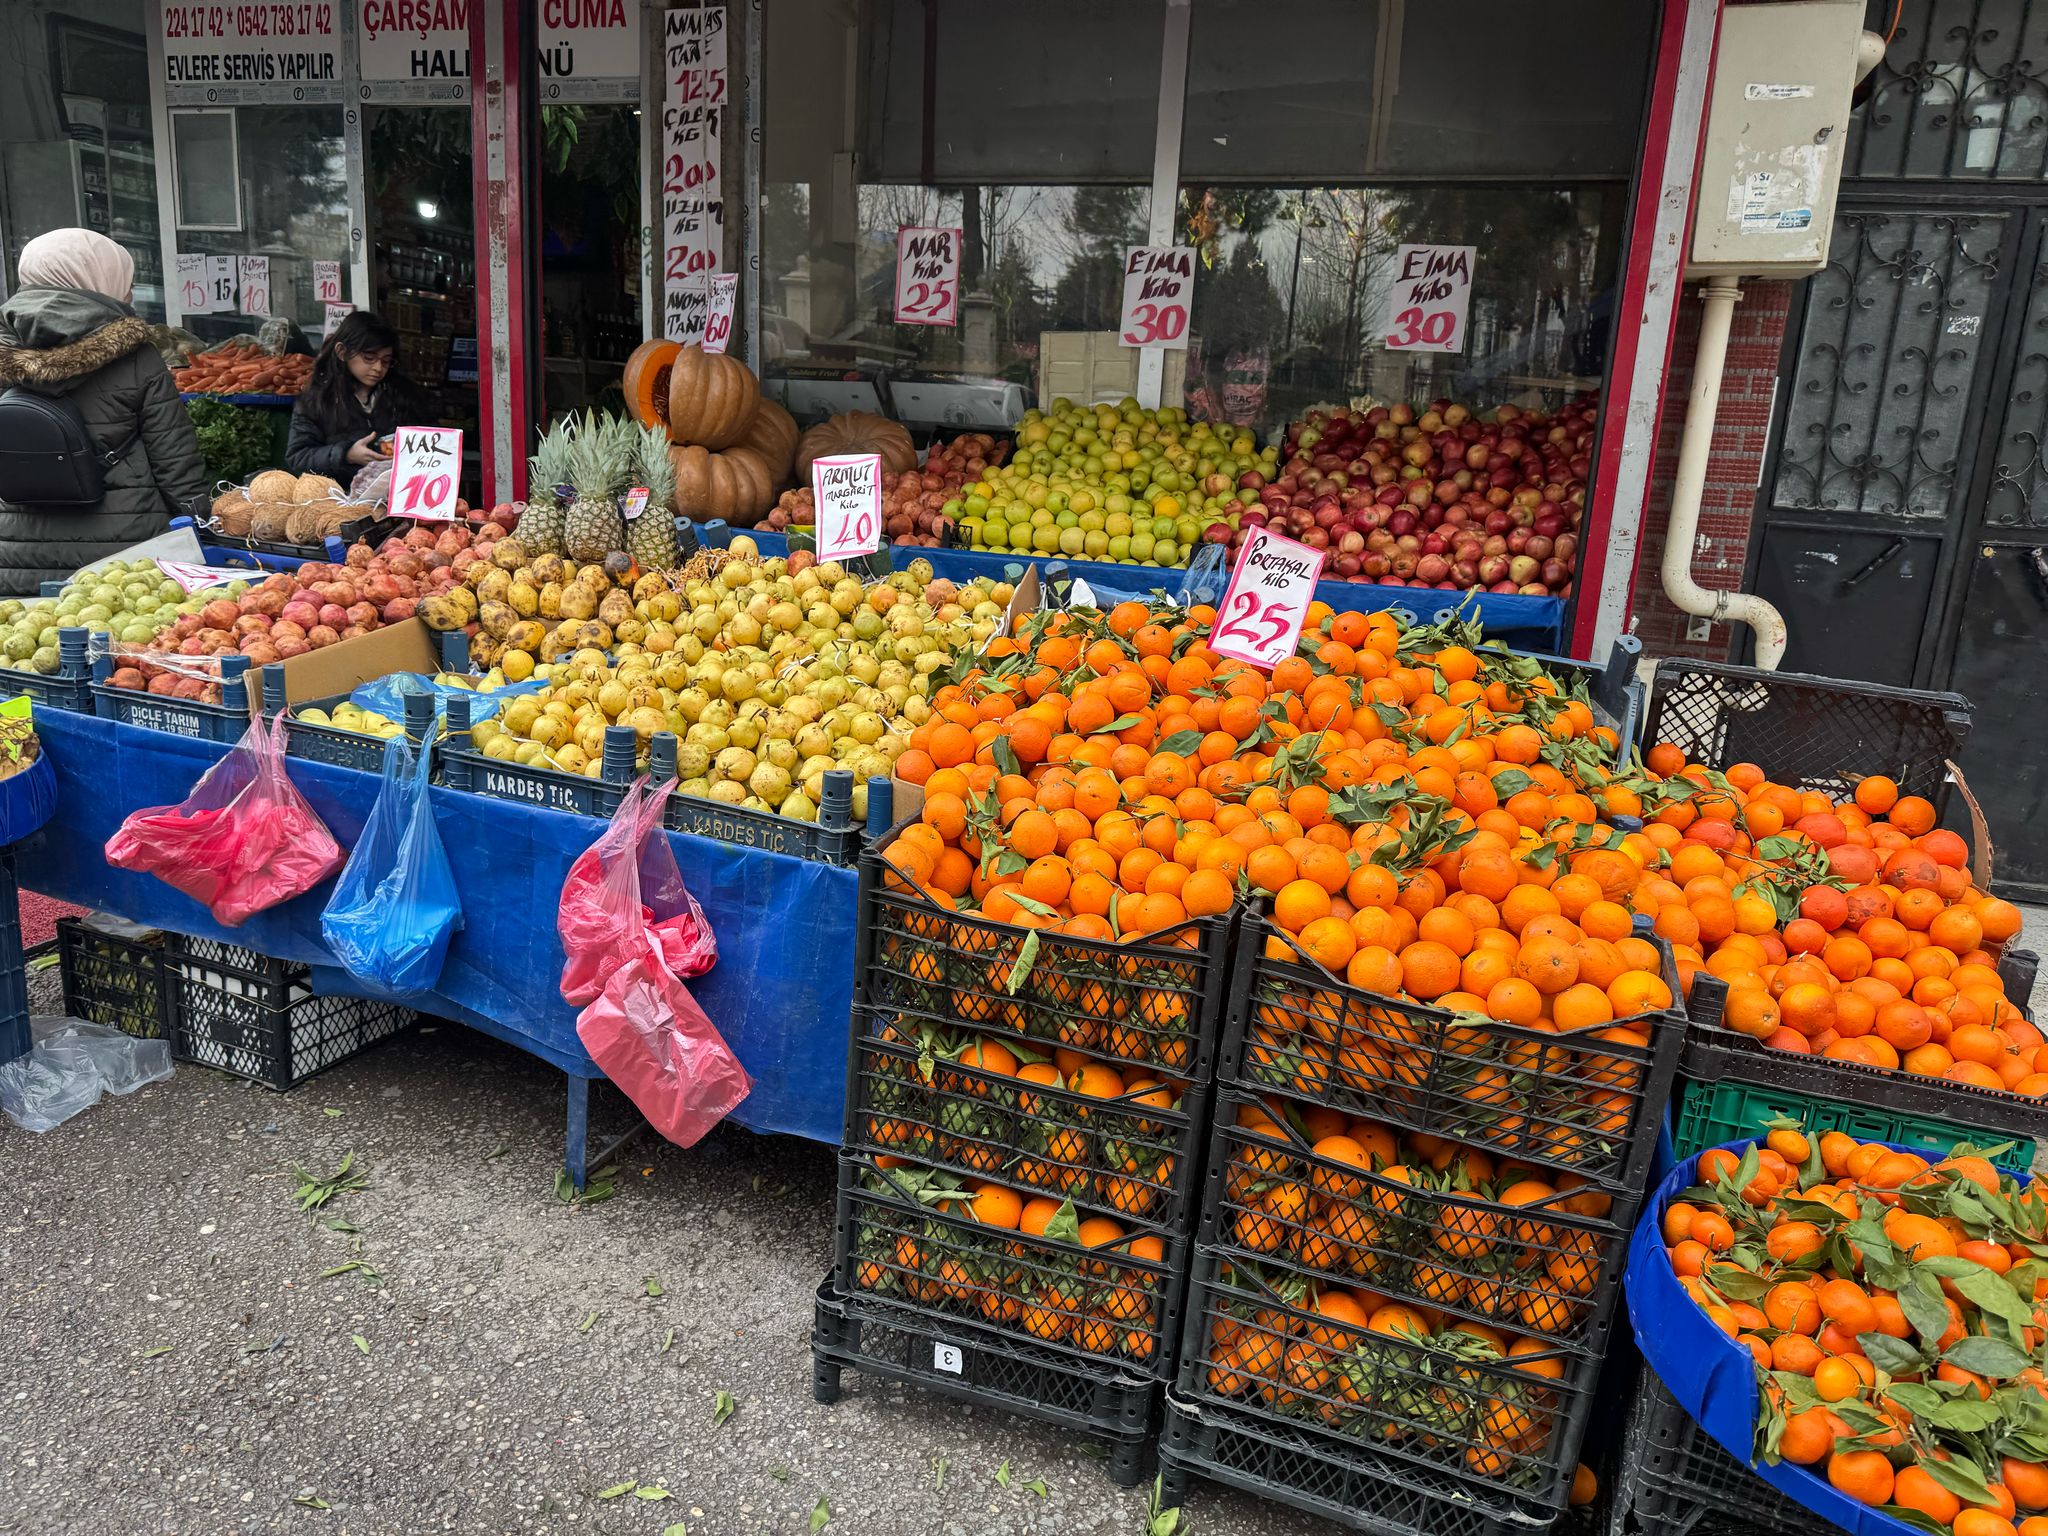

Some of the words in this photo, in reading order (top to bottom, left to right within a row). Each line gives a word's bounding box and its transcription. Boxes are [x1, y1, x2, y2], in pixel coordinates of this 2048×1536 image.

[166, 8, 188, 37] 224
[191, 7, 204, 36] 17
[209, 7, 224, 36] 42
[237, 6, 268, 35] 0542
[271, 5, 294, 35] 738
[298, 5, 311, 34] 17
[315, 4, 331, 34] 42
[364, 0, 470, 41] ÇARŞAM
[544, 0, 626, 29] CUMA
[167, 55, 220, 81] EVLERE
[224, 47, 275, 81] SERVİS
[277, 53, 334, 80] YAPILIR
[672, 128, 700, 145] KG
[673, 217, 700, 235] KG
[903, 232, 953, 264] NAR
[912, 260, 943, 279] Kilo
[182, 280, 206, 307] 15
[214, 278, 231, 300] 15
[243, 285, 265, 313] 10
[320, 281, 337, 298] 10
[901, 279, 955, 317] 25
[705, 313, 730, 343] 60
[1123, 303, 1187, 344] 30
[1386, 307, 1457, 346] 30
[400, 432, 453, 455] NAR
[823, 463, 874, 488] ARMUT
[399, 472, 451, 512] 10
[830, 512, 873, 550] 40
[1219, 591, 1298, 652] 25
[164, 711, 200, 729] TARIM
